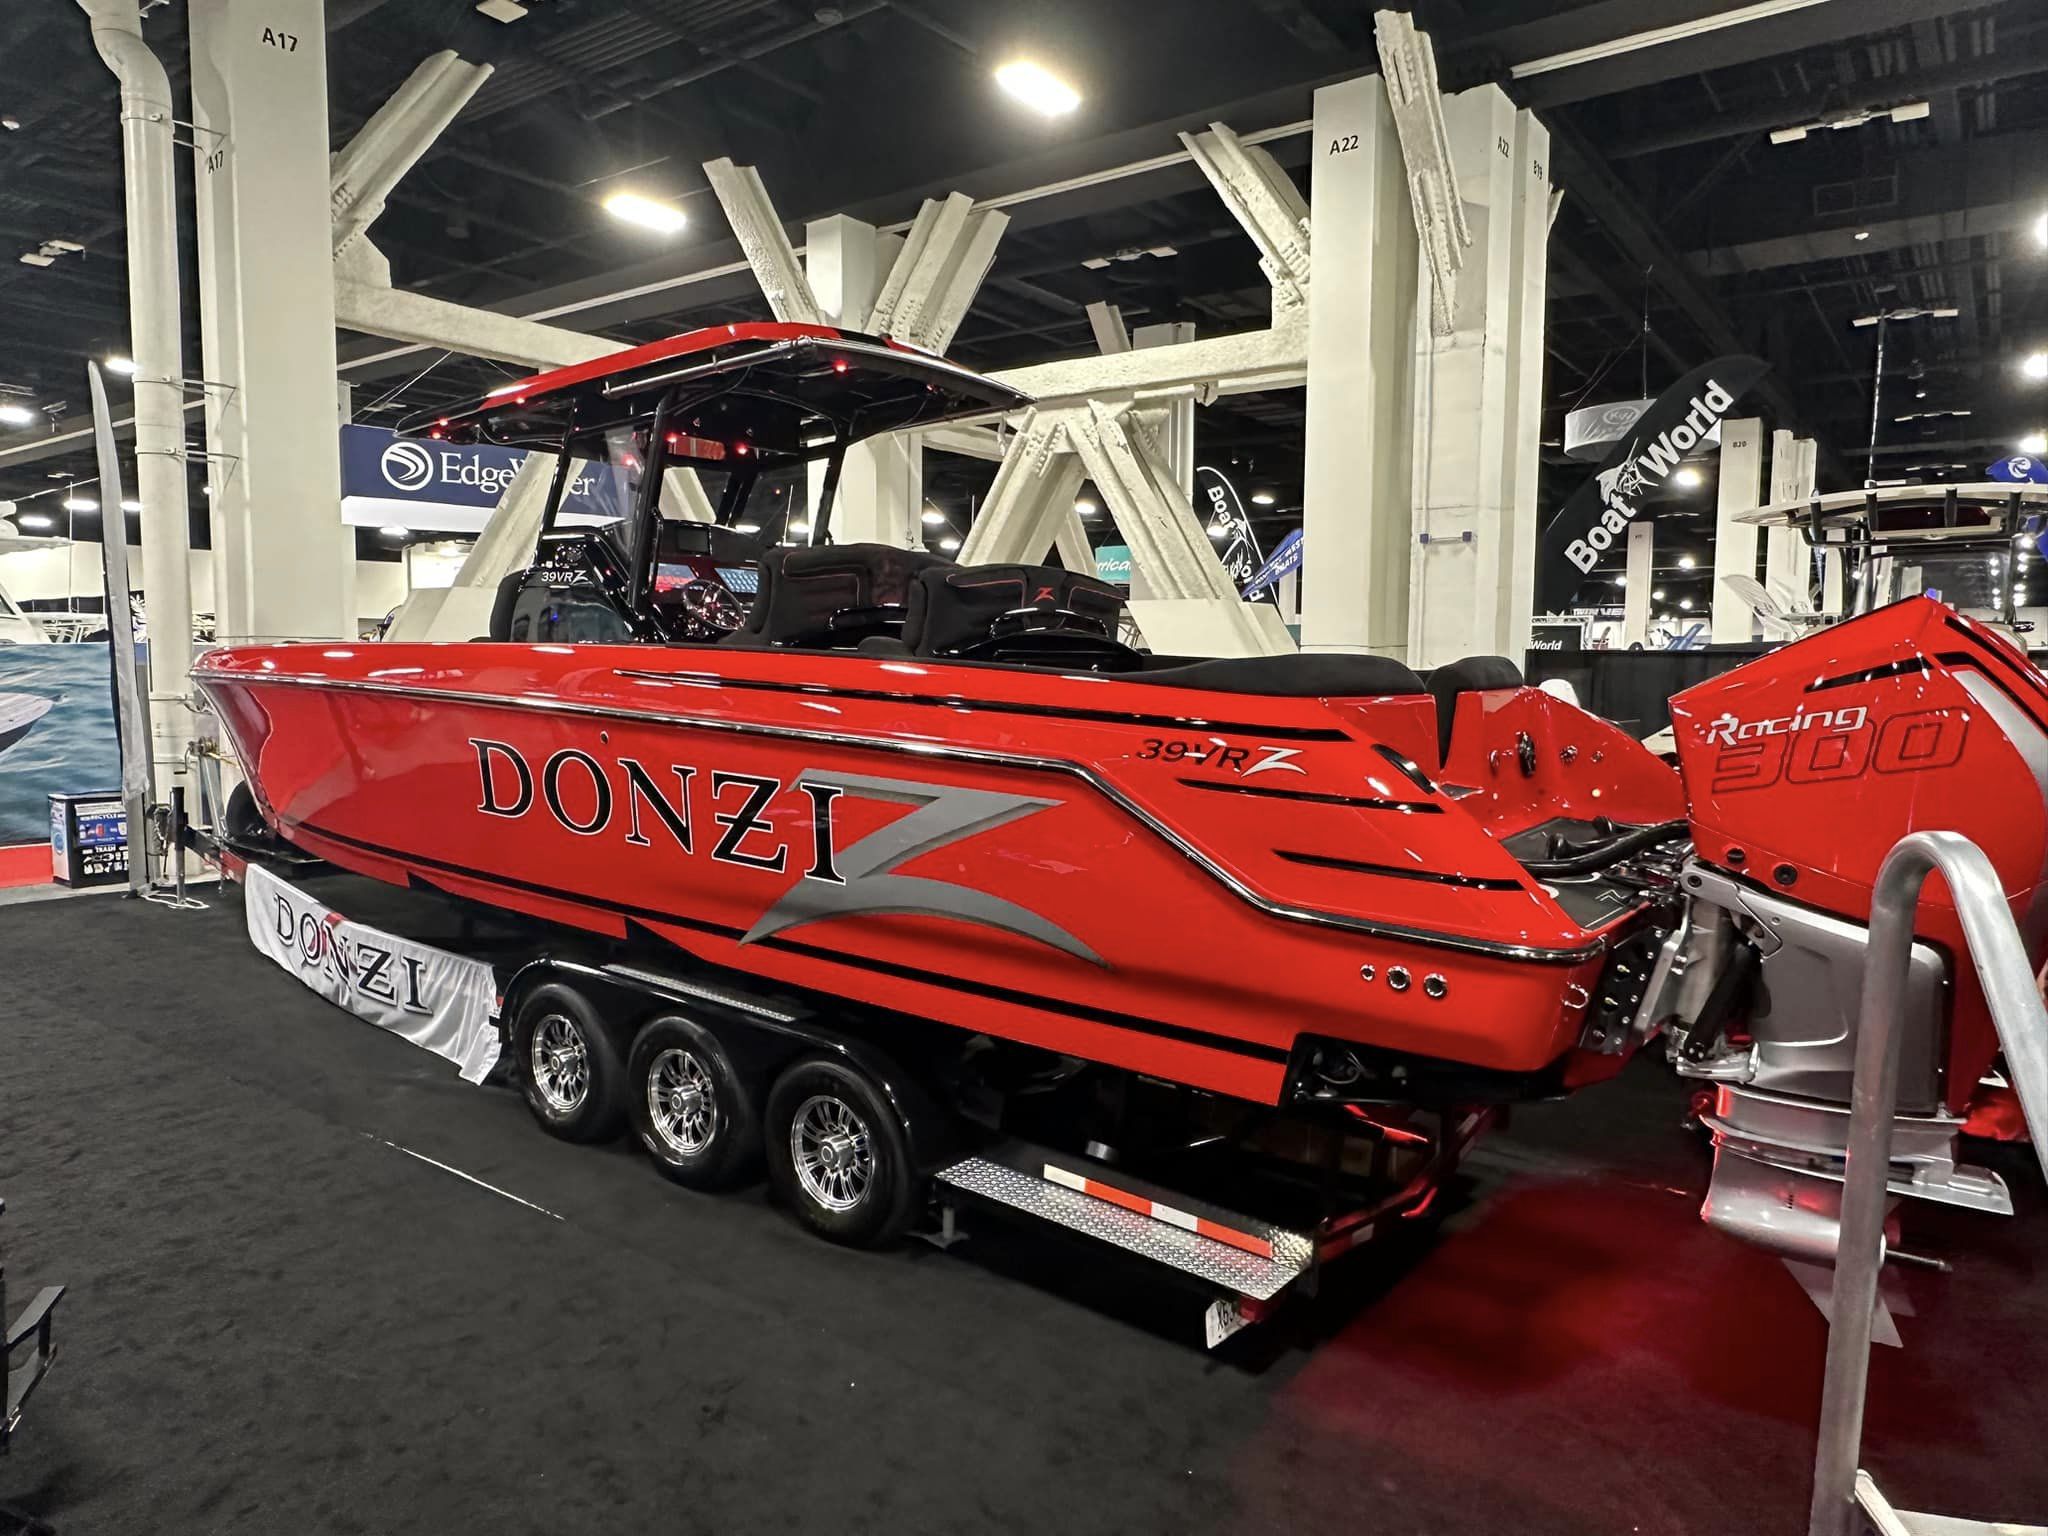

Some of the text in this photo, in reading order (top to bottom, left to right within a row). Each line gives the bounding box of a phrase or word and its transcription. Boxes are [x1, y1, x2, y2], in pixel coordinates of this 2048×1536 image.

[262, 27, 298, 52] A17
[208, 150, 224, 175] A17
[1329, 134, 1359, 156] A22
[1497, 135, 1509, 158] A22
[440, 452, 595, 496] Edgeer
[1564, 378, 1735, 576] Boat World
[1530, 640, 1562, 650] World
[1706, 706, 1868, 745] Racing
[1712, 706, 1970, 794] 300
[467, 737, 847, 887] DONZI
[273, 892, 434, 1016] DONZI
